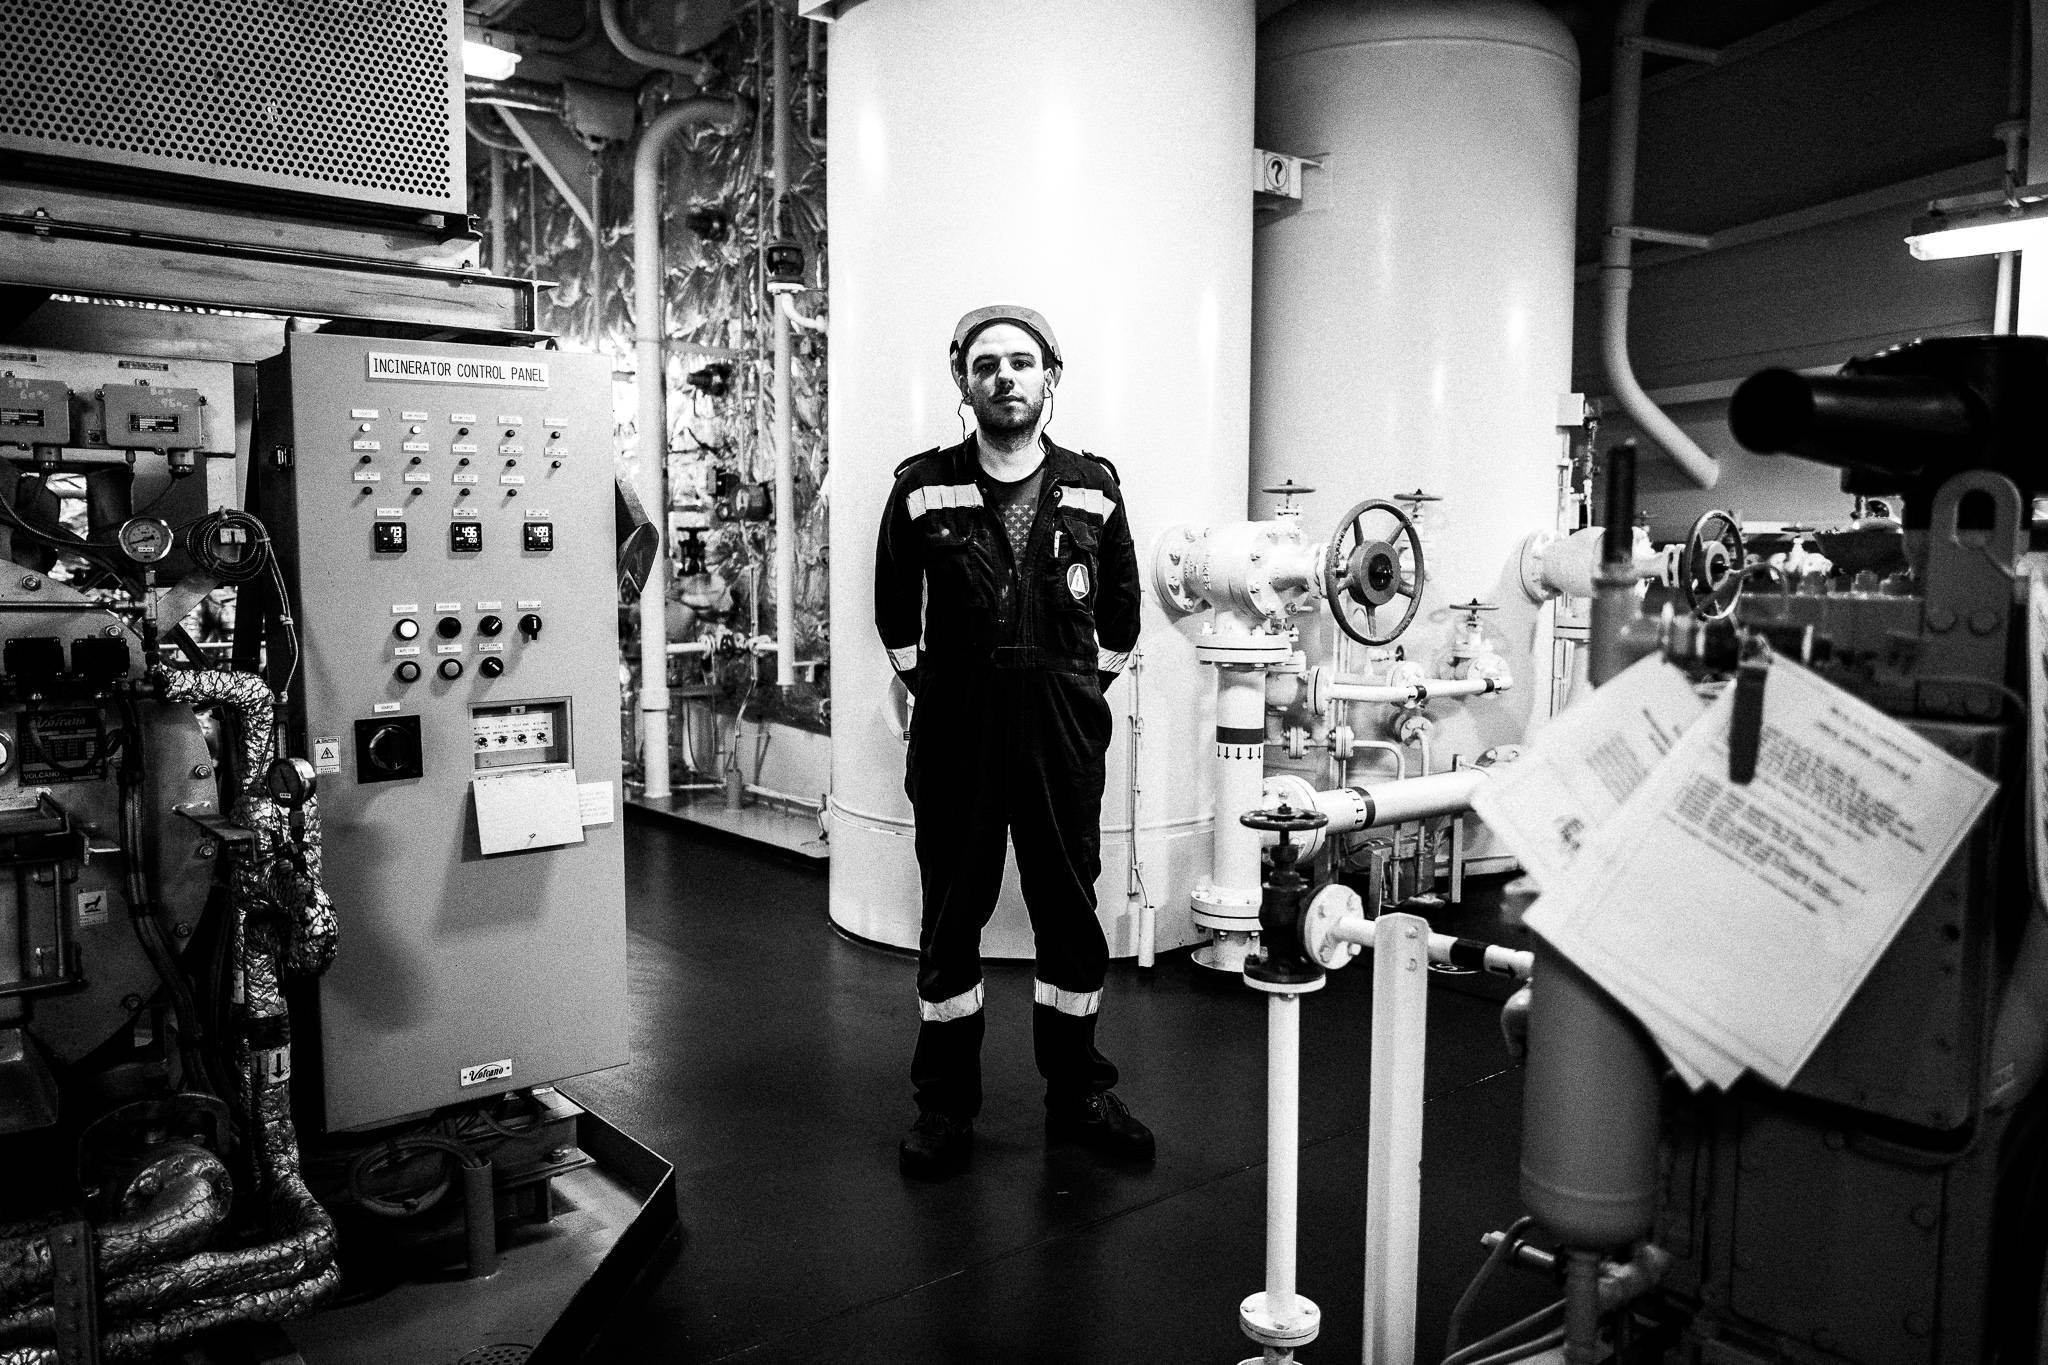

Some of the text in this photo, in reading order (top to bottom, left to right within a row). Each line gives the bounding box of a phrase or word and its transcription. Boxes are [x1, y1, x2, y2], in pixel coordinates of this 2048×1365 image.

[373, 357, 545, 382] INCINERATOR CONTROL PANEL
[23, 771, 60, 781] VOLCANO
[469, 1064, 504, 1081] Volcano
